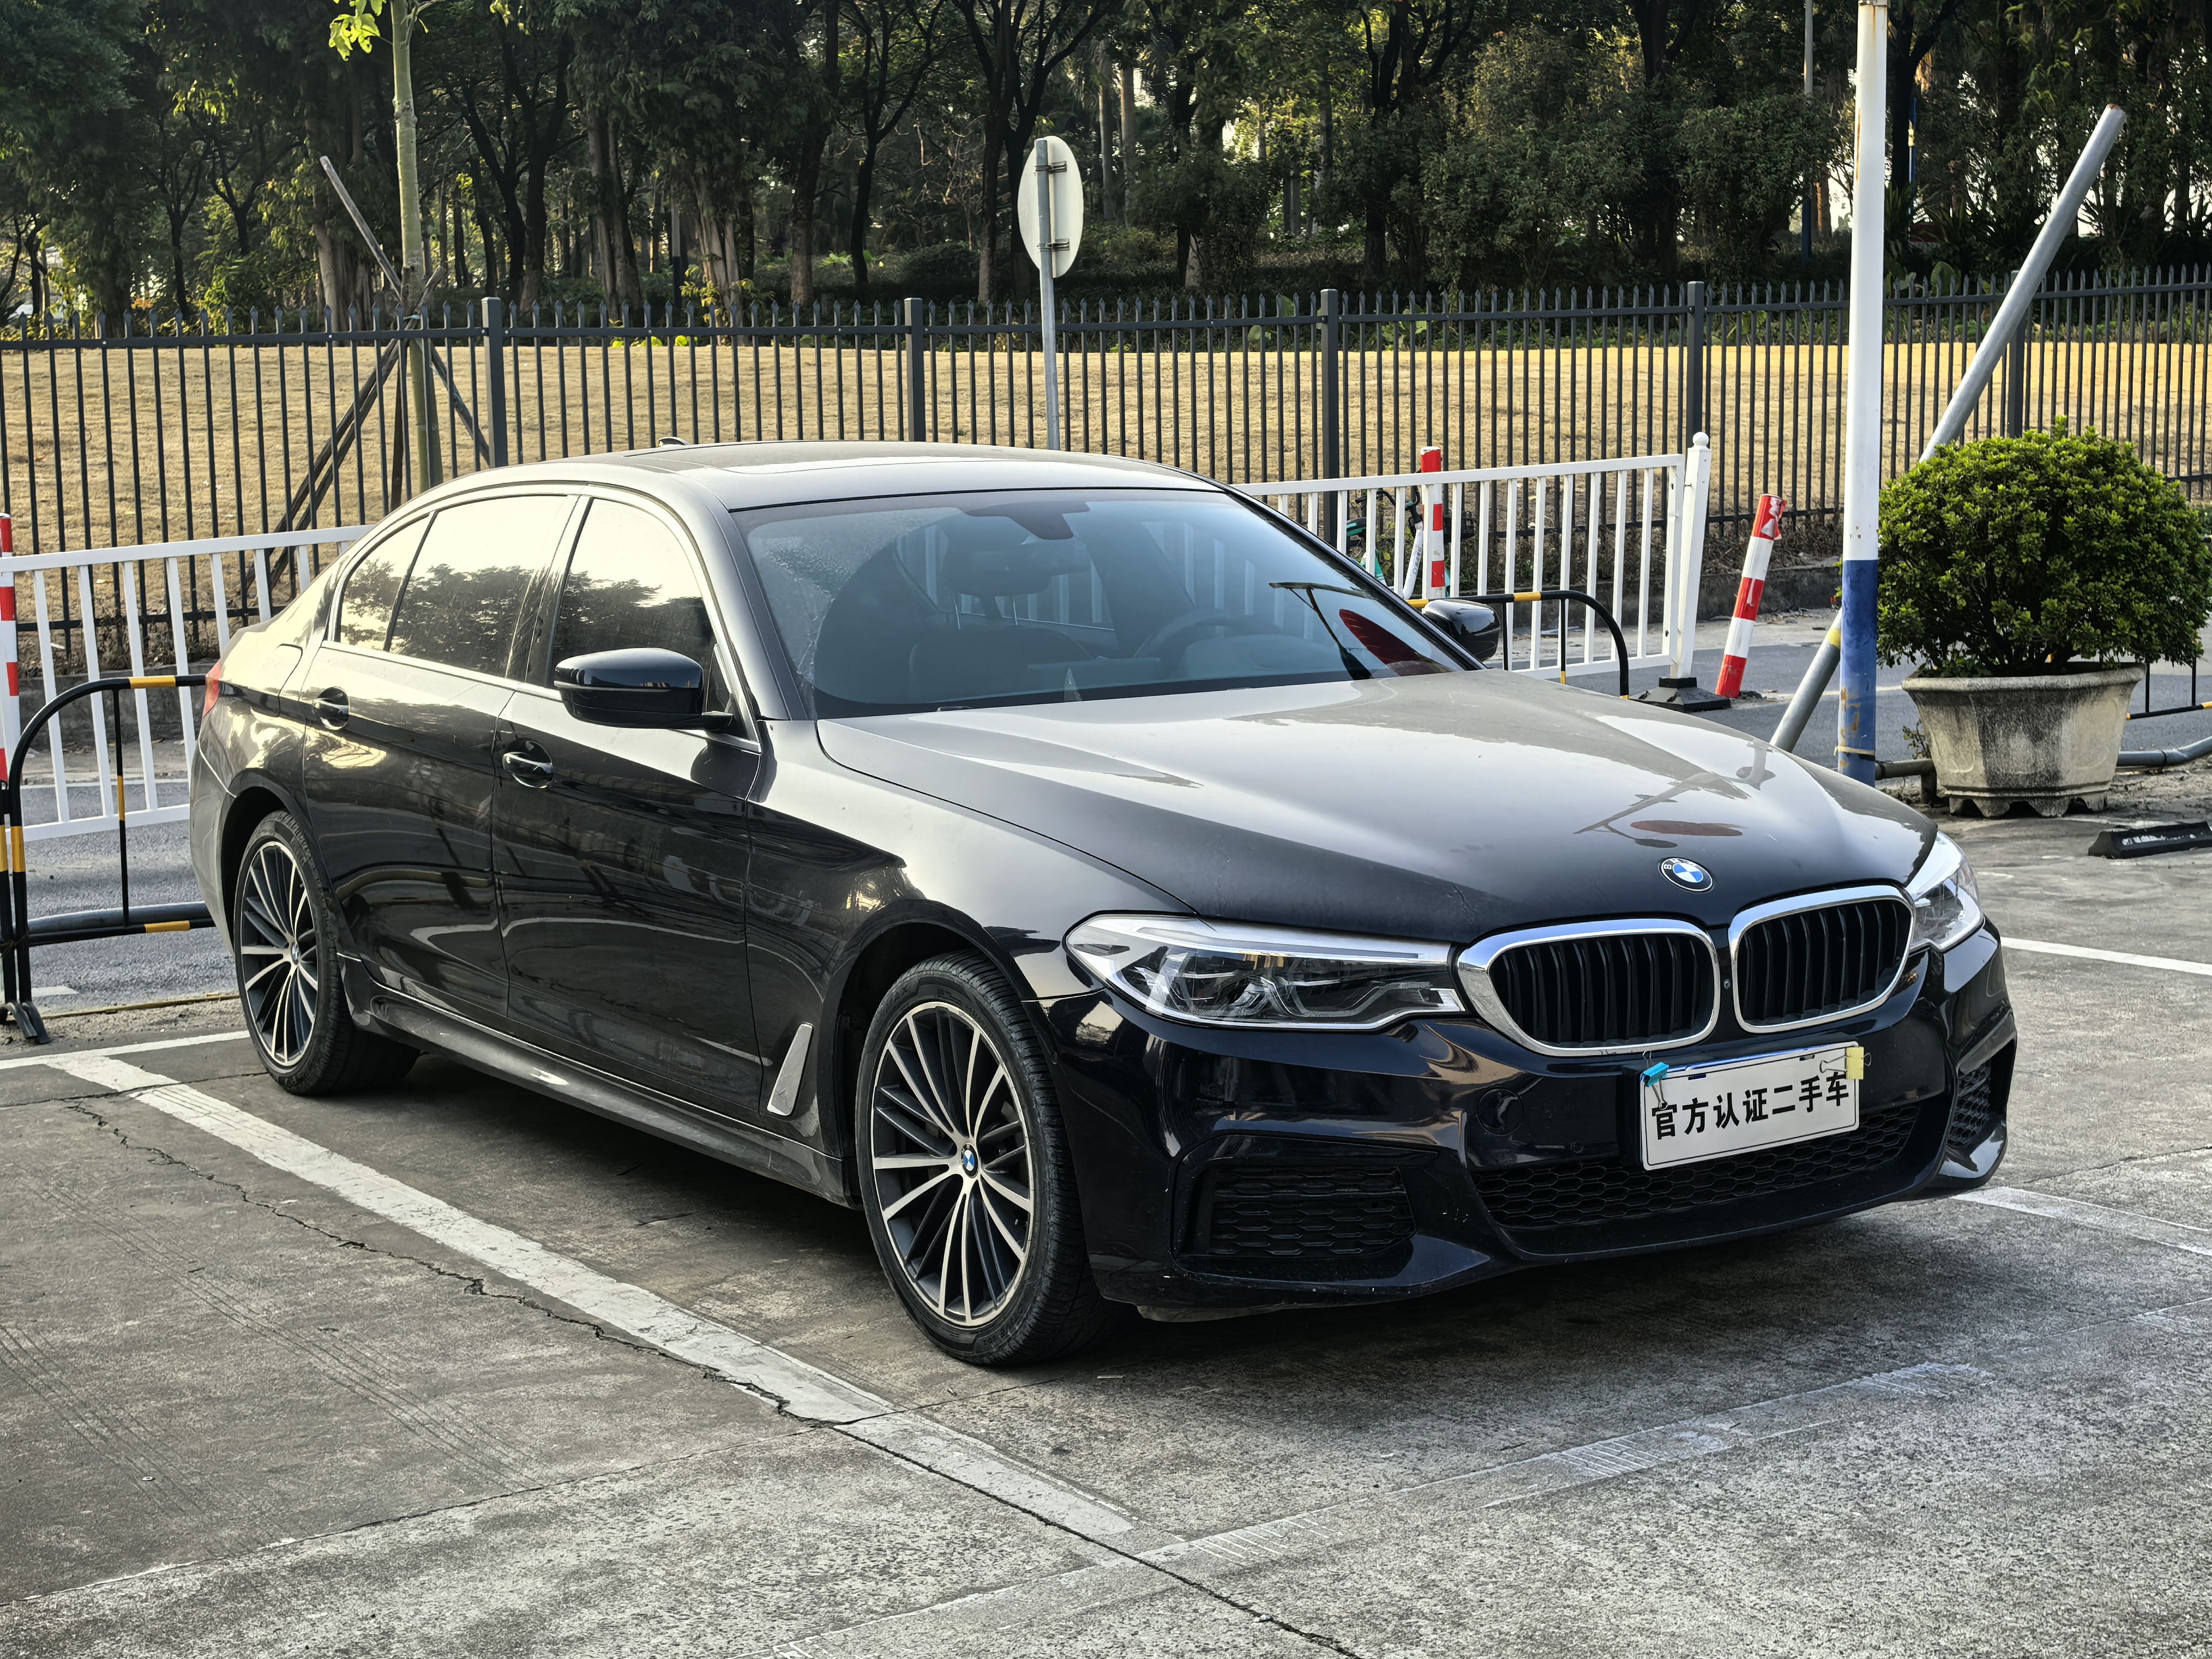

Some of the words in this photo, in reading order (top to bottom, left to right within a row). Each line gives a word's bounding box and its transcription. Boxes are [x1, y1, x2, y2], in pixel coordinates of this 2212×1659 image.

[1663, 859, 1697, 869] BMW
[1651, 1071, 1849, 1140] 官方认证二手车
